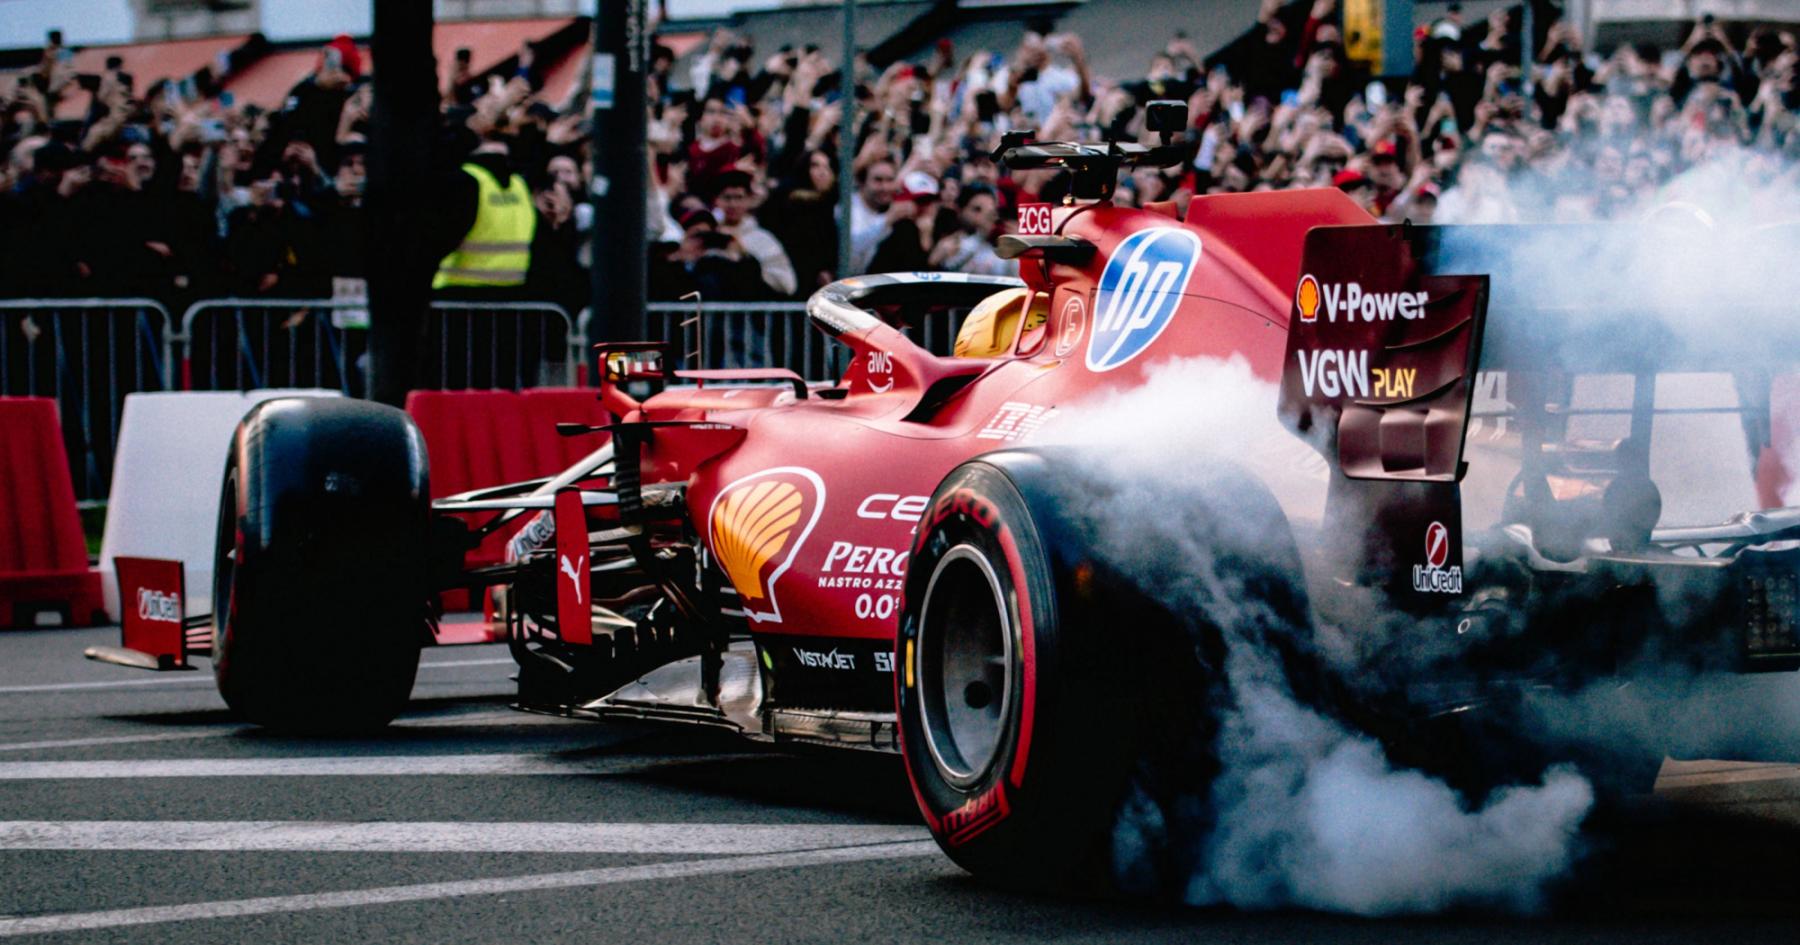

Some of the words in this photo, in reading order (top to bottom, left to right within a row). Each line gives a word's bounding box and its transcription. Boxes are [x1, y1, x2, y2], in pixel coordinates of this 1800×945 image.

[1018, 206, 1051, 234] ZCG
[1322, 282, 1429, 323] V-Power
[867, 351, 894, 374] aws
[1297, 349, 1369, 398] VGW
[1371, 368, 1417, 398] PLAY
[818, 577, 872, 589] NASTRO
[1413, 564, 1462, 594] UniCredit
